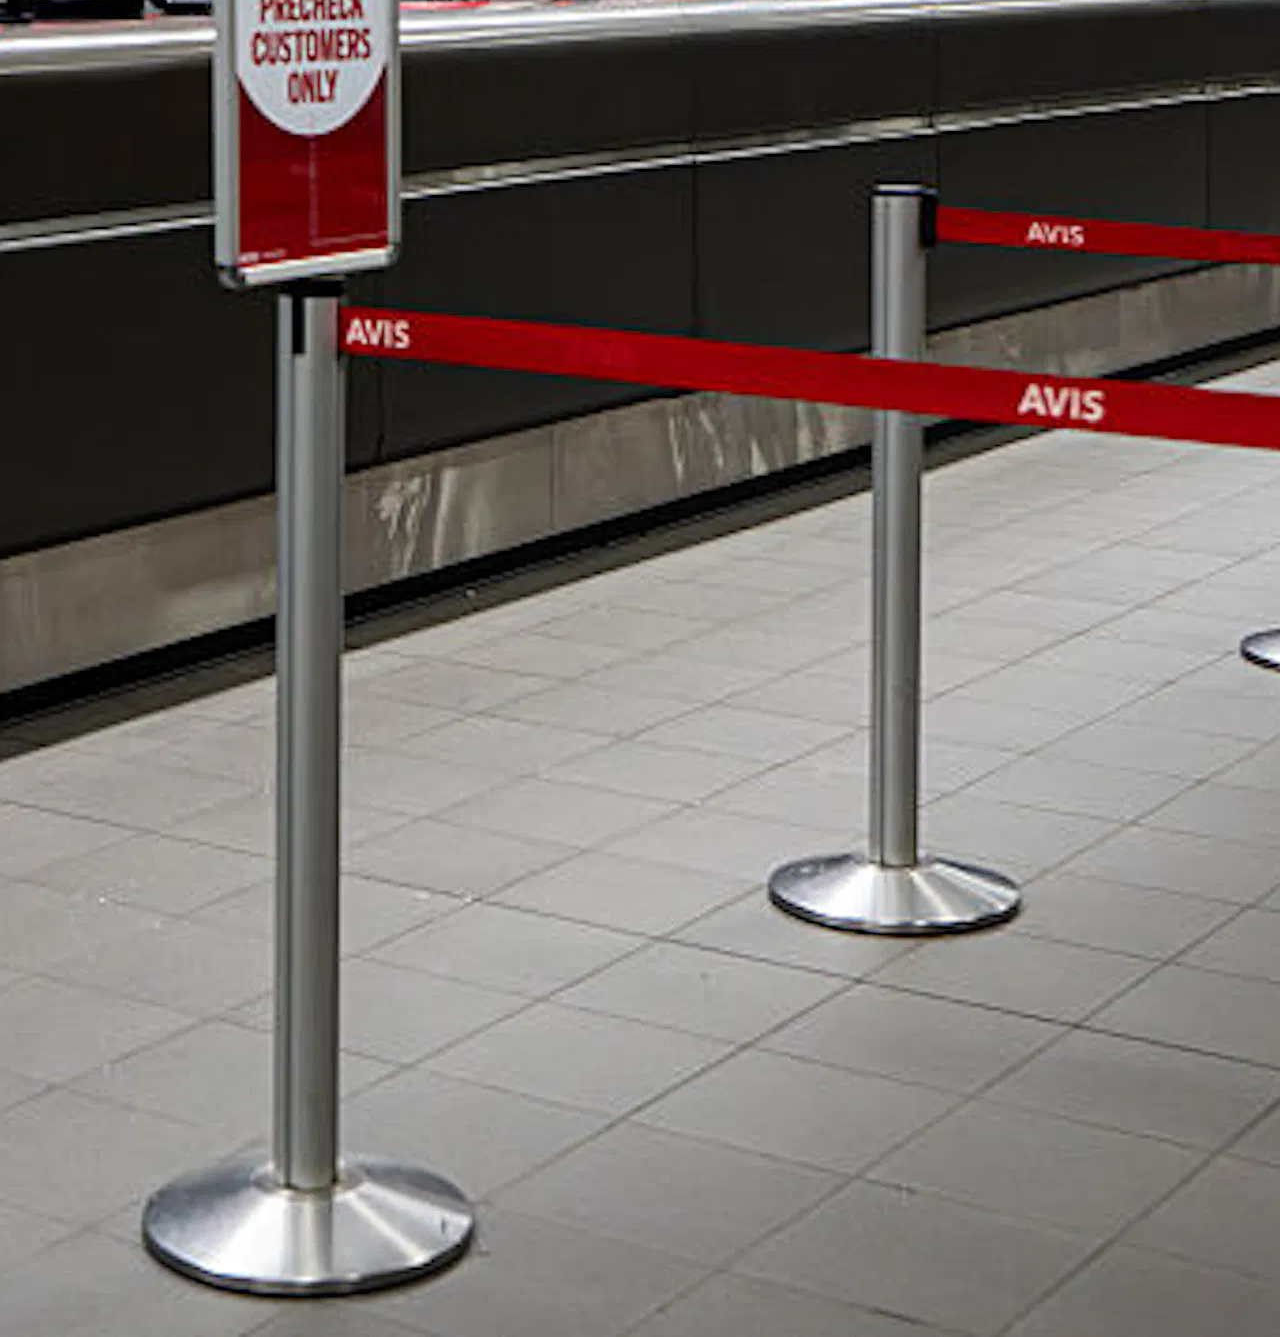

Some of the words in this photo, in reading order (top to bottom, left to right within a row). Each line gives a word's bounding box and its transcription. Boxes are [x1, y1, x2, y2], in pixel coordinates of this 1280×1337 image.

[251, 29, 372, 65] CUSTOMERS
[288, 70, 338, 104] ONLY
[1027, 221, 1085, 247] AVIS
[345, 318, 411, 349] AVIS
[1018, 382, 1106, 425] AVIS
